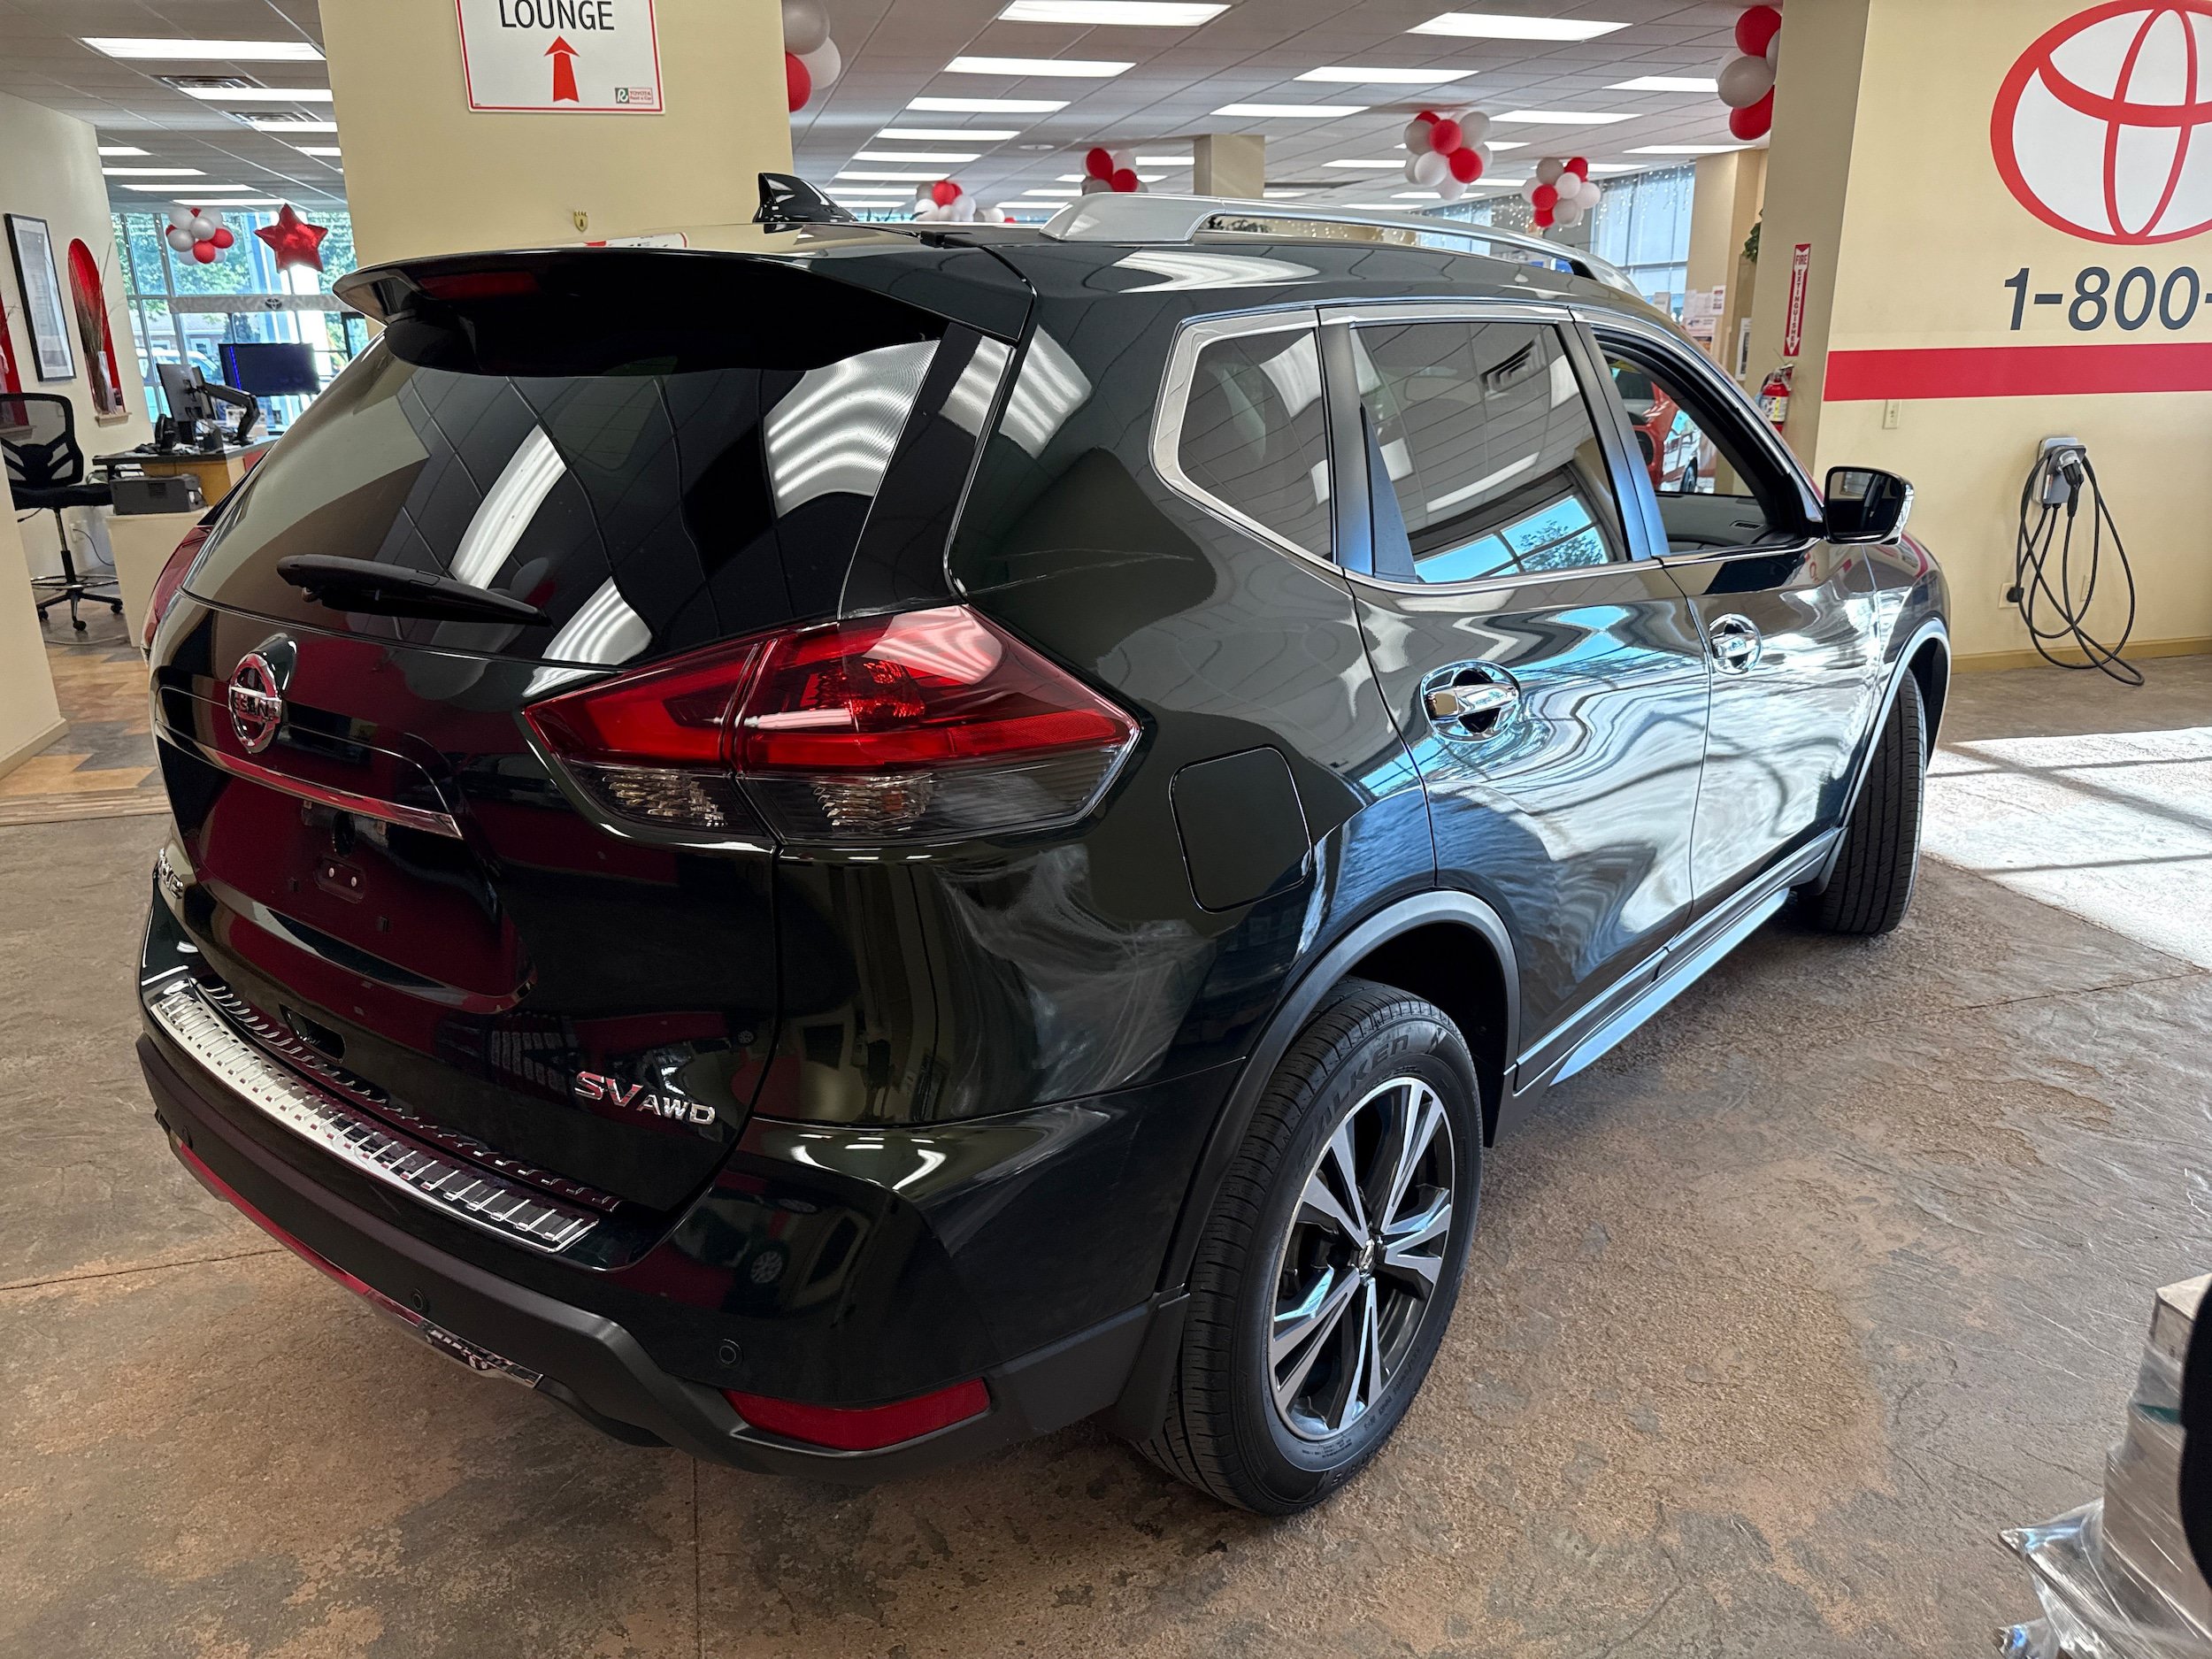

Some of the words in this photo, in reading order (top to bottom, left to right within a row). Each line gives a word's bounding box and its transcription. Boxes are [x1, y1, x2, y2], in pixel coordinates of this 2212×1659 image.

[499, 0, 615, 30] LOUNGE
[1795, 254, 1808, 265] FIRE
[1789, 268, 1803, 349] EXTINGUISHER
[2004, 265, 2212, 332] 1-800
[574, 1071, 644, 1108] SV
[635, 1094, 716, 1125] AWD
